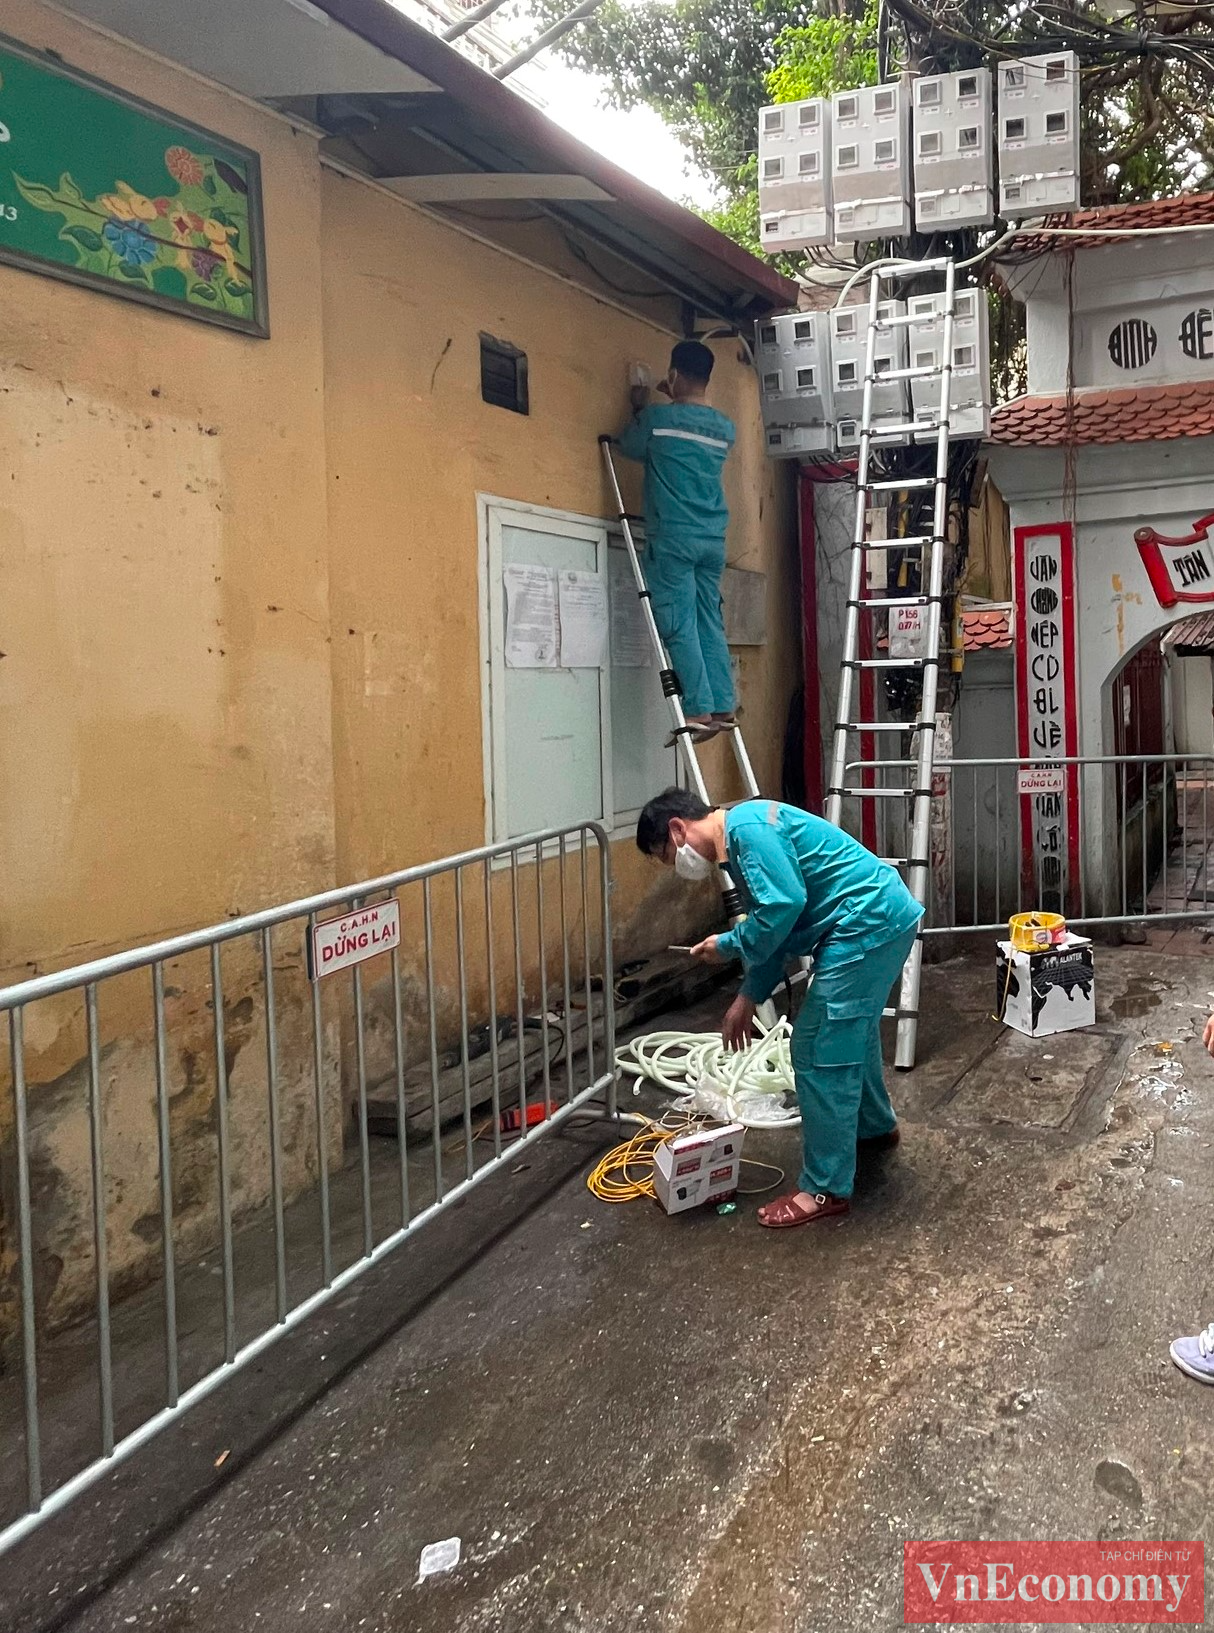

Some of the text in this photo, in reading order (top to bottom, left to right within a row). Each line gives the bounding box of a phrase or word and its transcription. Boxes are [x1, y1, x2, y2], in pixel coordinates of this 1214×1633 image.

[1172, 549, 1211, 588] TÂN
[322, 921, 396, 962] DỪNG LẠI
[340, 911, 379, 933] C.A.H.N
